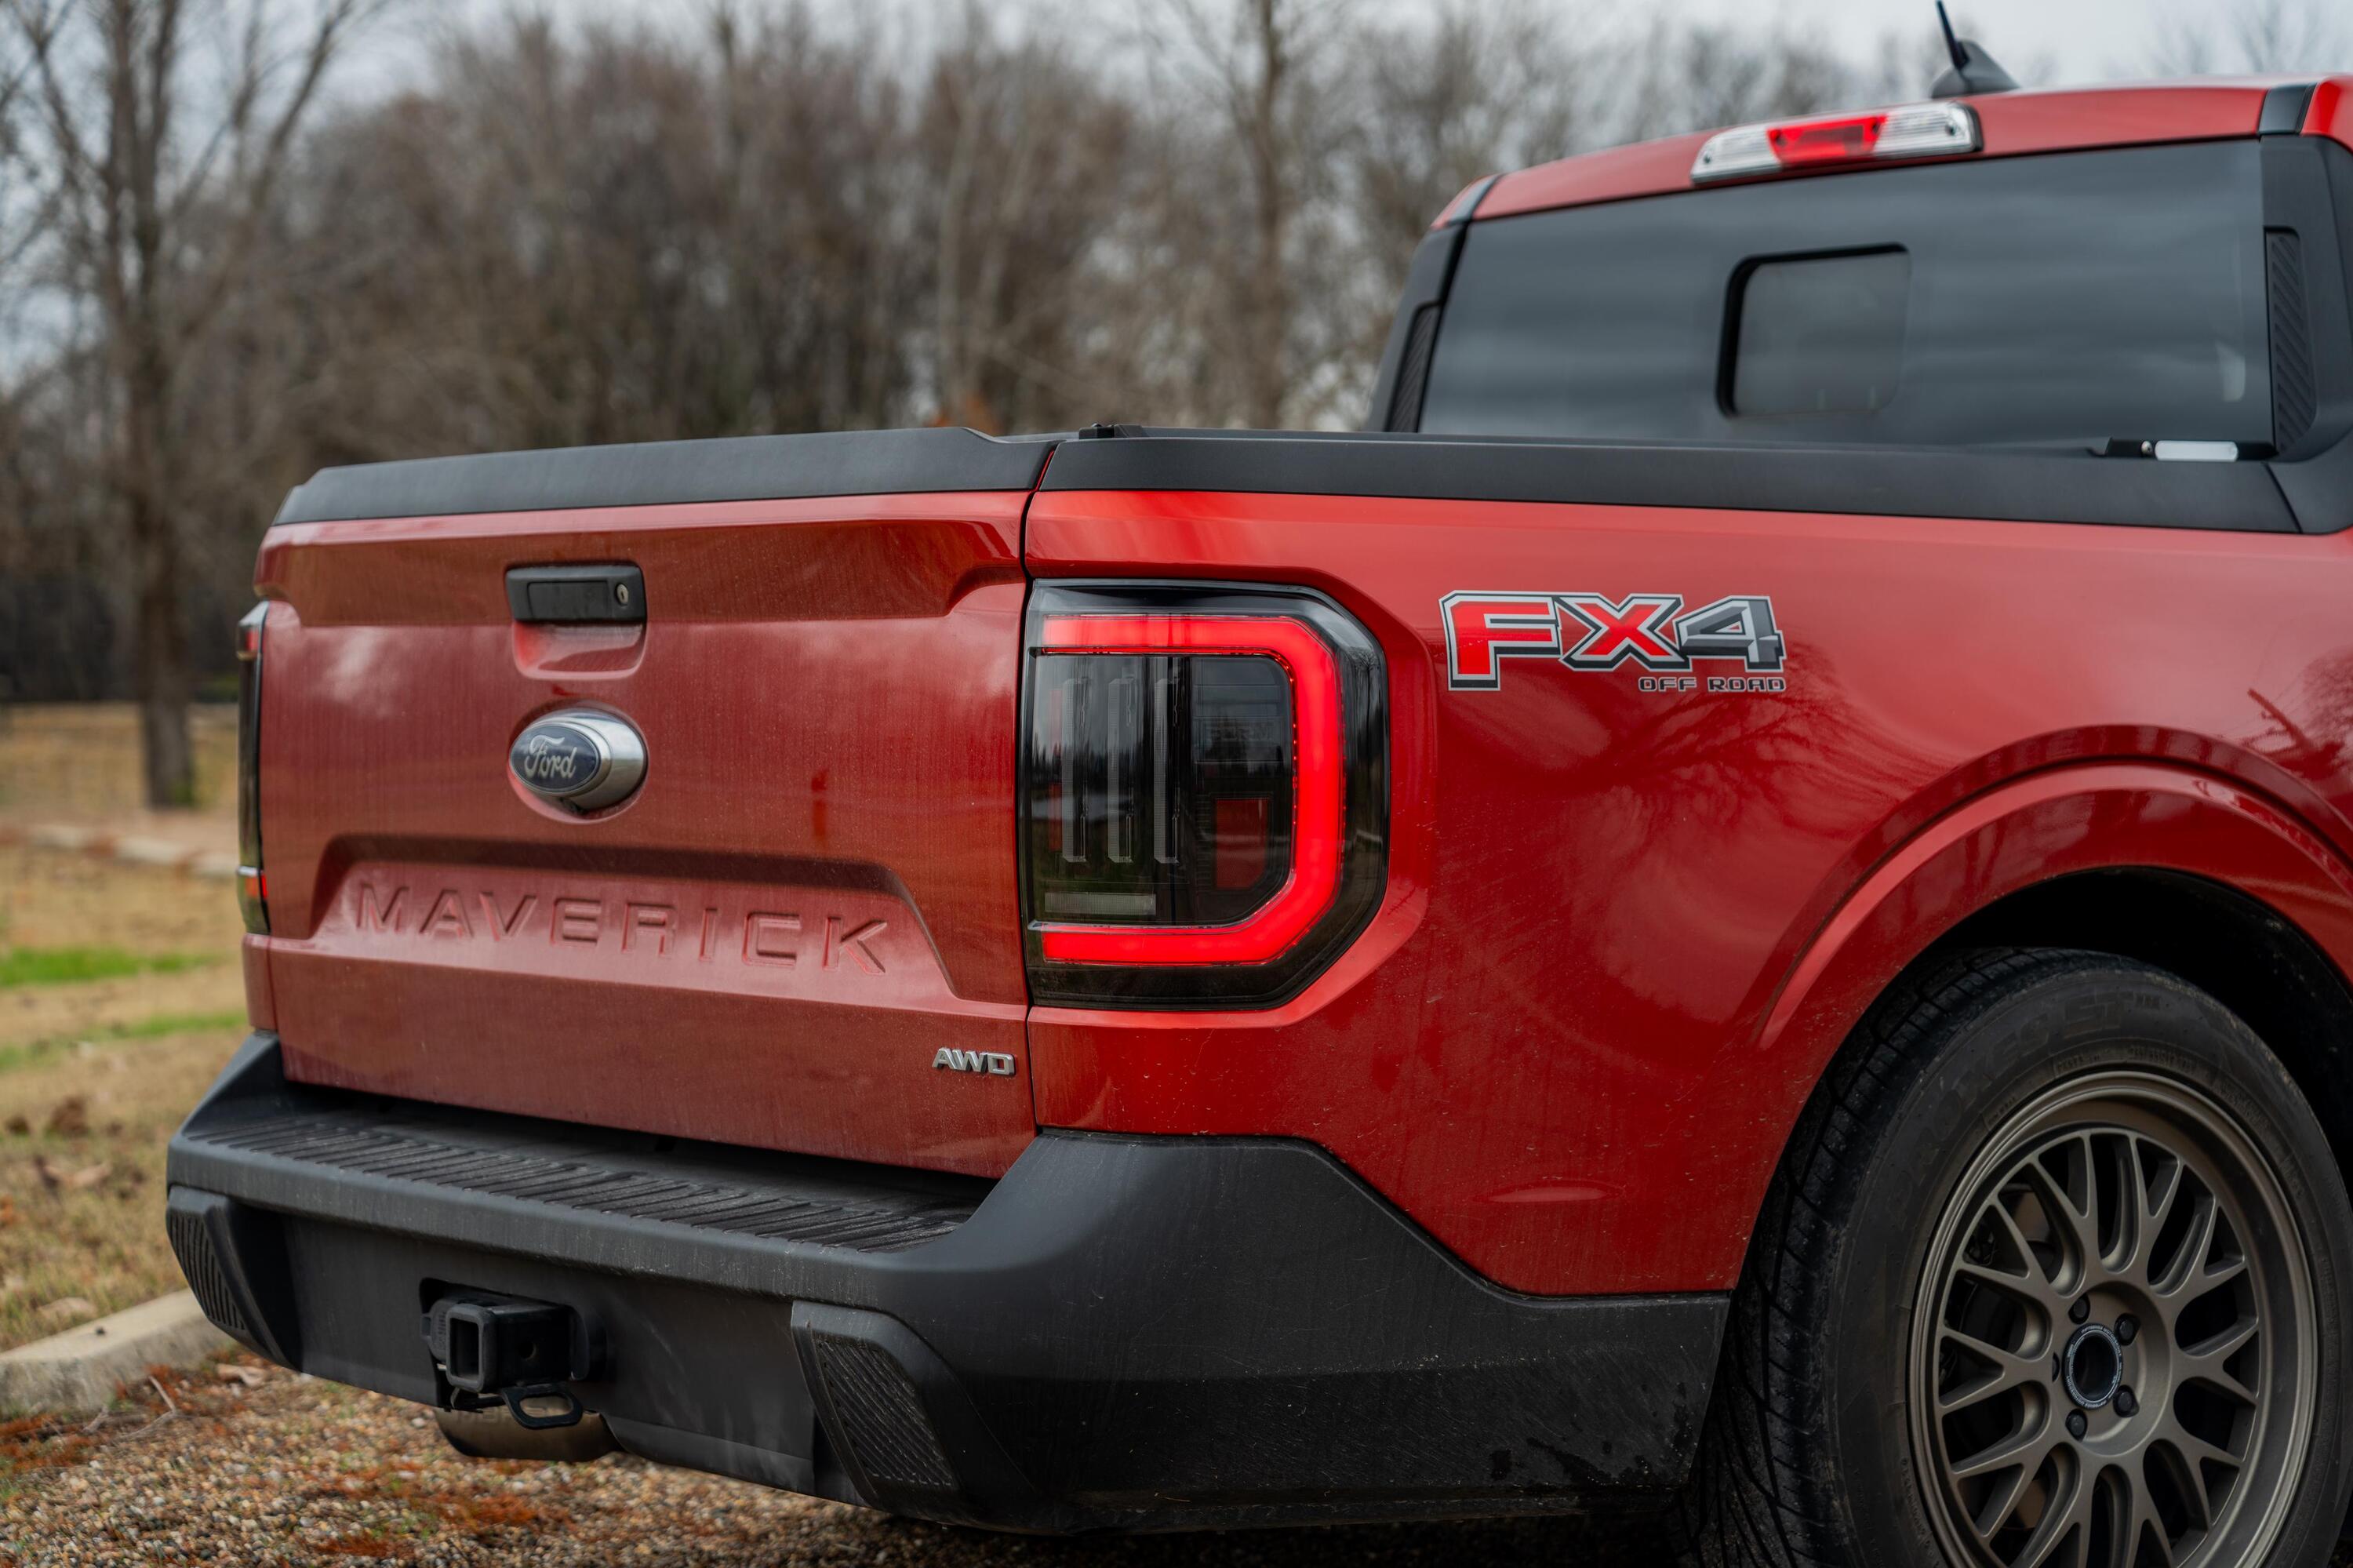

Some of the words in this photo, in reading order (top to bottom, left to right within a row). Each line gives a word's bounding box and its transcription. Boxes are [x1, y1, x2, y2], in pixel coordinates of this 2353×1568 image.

[1438, 590, 1785, 690] FX4
[1638, 676, 1697, 692] OFF
[1707, 676, 1786, 693] ROAD
[524, 734, 577, 779] Ford
[357, 882, 887, 974] MAVERICK
[932, 1046, 1016, 1076] AWD
